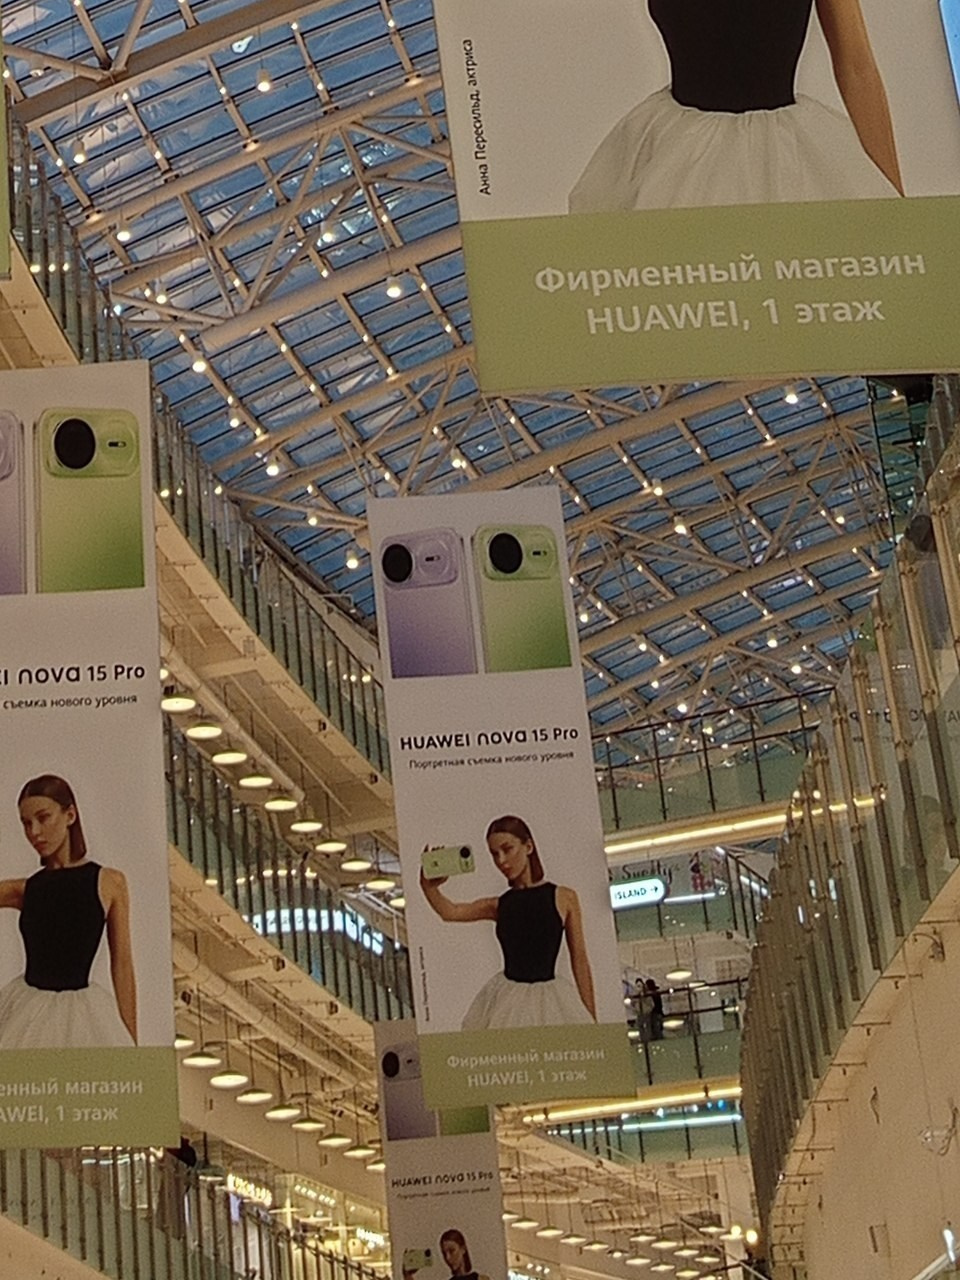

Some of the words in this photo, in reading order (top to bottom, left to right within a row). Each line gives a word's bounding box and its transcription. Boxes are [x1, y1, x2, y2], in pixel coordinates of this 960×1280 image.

[535, 253, 762, 296] Фирменный
[775, 254, 926, 280] магазин
[586, 300, 750, 334] HUAWEI,
[762, 298, 779, 325] 1
[796, 299, 885, 324] этаж
[18, 666, 80, 685] nova
[88, 666, 107, 682] 15
[114, 664, 145, 680] Pro
[3, 698, 47, 710] съемка
[51, 696, 91, 708] нового
[95, 694, 137, 708] уровня
[400, 733, 470, 751] HUAWEI
[477, 730, 527, 746] nova
[532, 728, 548, 742] 15
[553, 727, 579, 740] Pro
[447, 1049, 539, 1069] Фирменный
[543, 1048, 605, 1061] магазин
[65, 1080, 143, 1094] магазин
[467, 1071, 534, 1087] HUAWEI,
[538, 1070, 545, 1082] 1
[552, 1070, 587, 1082] этаж
[56, 1105, 65, 1120] 1
[73, 1106, 118, 1121] этаж
